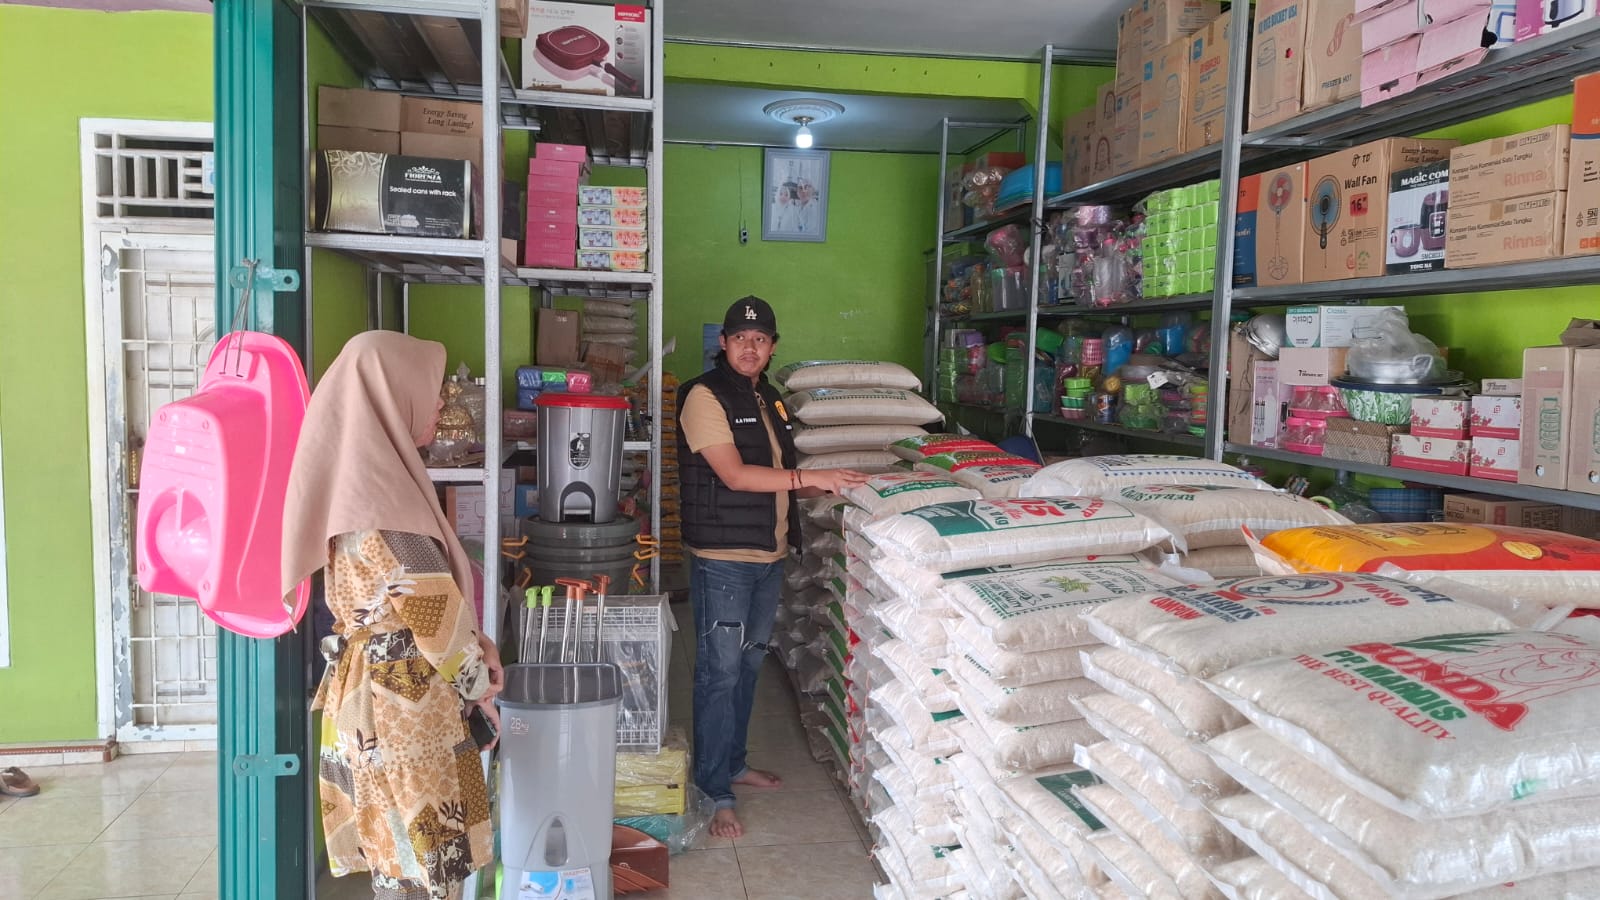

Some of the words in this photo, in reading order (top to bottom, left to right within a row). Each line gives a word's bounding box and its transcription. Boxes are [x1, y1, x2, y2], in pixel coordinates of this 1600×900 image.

[423, 107, 444, 117] Energy
[446, 110, 468, 119] Saving
[428, 117, 444, 127] Long
[447, 119, 474, 129] Lasting!
[1514, 153, 1533, 161] Tungku
[1428, 169, 1449, 180] COM
[1504, 169, 1547, 187] Rinnai
[1344, 176, 1361, 190] Wall
[1361, 175, 1378, 186] Fan
[389, 186, 412, 194] Sealed
[428, 187, 442, 196] with
[442, 189, 457, 197] rack
[1503, 235, 1547, 250] Rinnai
[745, 305, 757, 320] LA
[1195, 592, 1261, 620] MARDIS
[1321, 650, 1370, 668] PP.
[1352, 664, 1467, 721] MARDIS
[1344, 641, 1530, 732] BUNDA
[1290, 654, 1330, 671] THE
[1321, 668, 1374, 692] BEST
[1367, 690, 1455, 740] QUALITY
